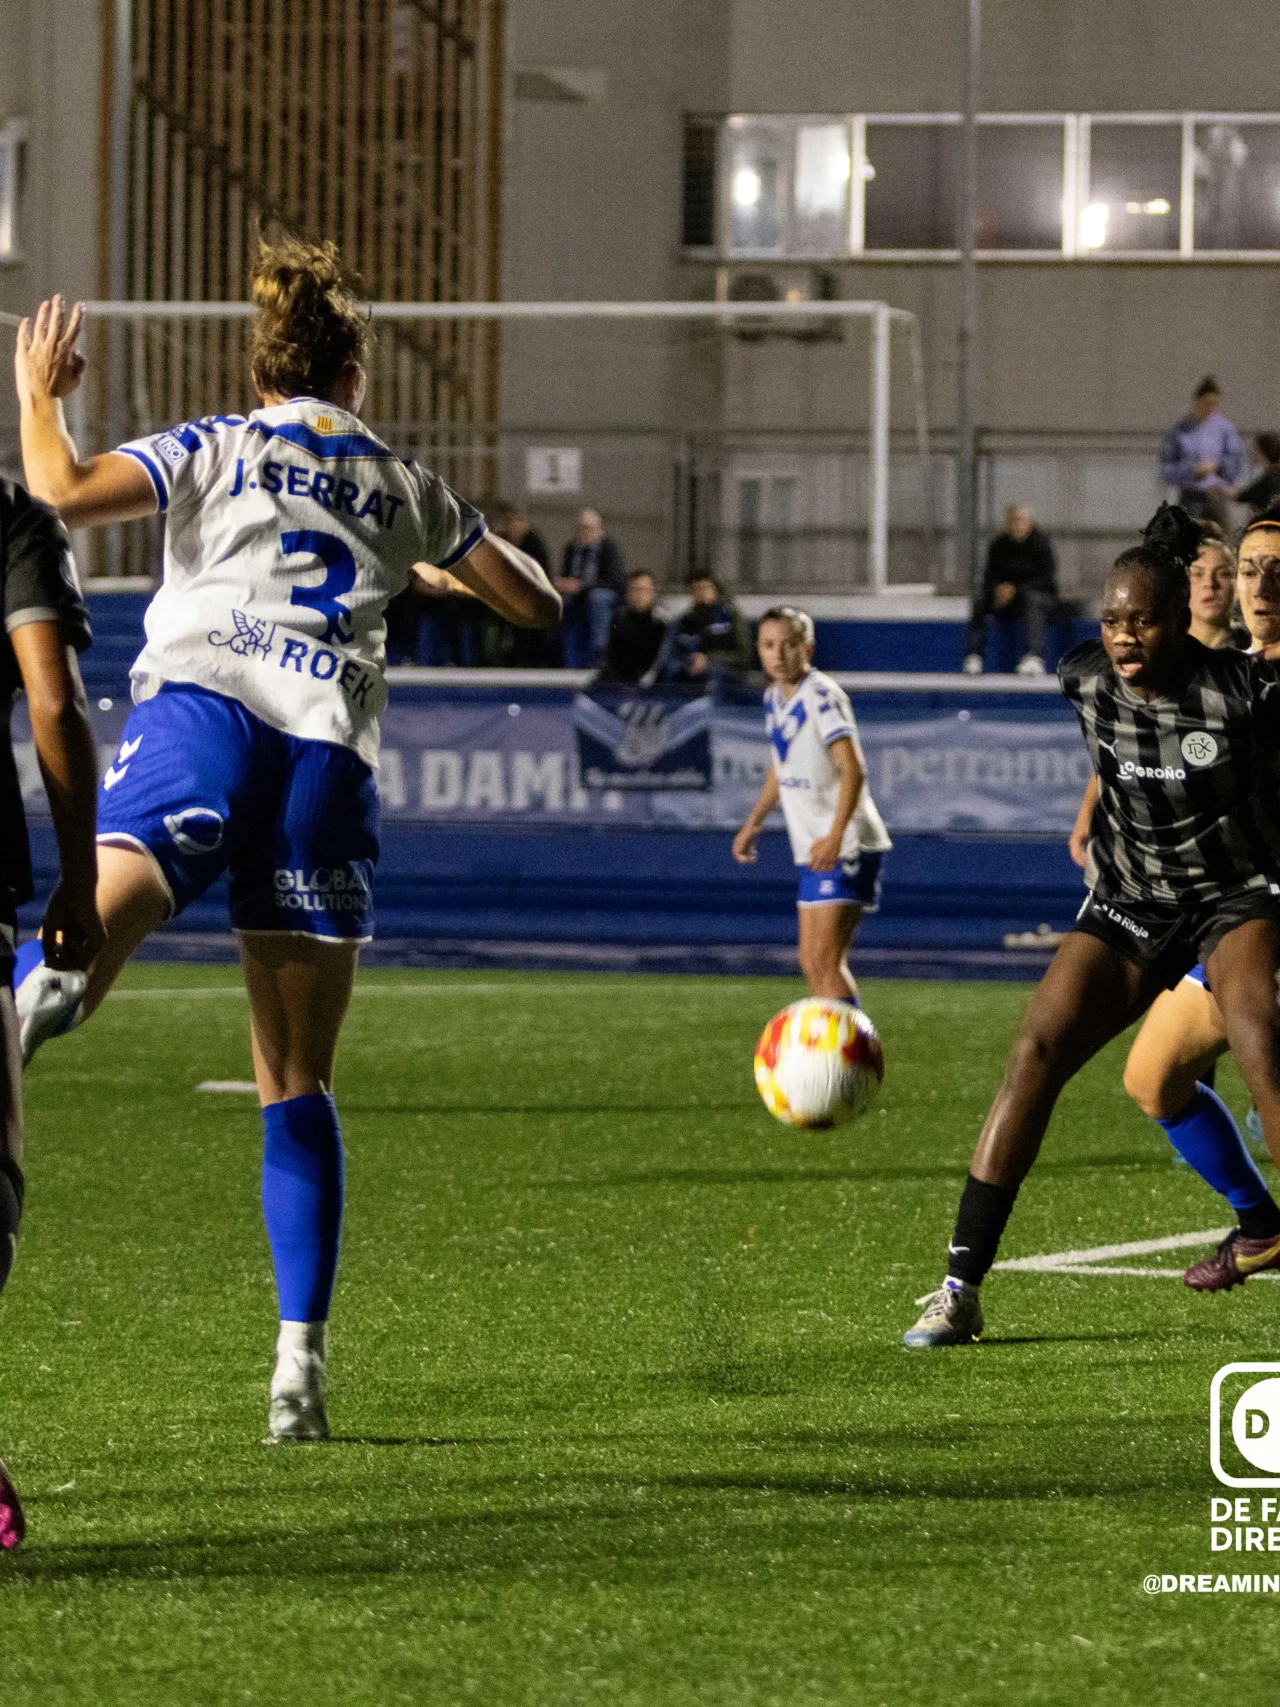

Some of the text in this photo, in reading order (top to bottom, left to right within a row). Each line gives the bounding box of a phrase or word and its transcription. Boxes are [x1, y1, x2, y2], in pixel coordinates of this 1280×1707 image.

[229, 458, 404, 529] J.SERRAT
[281, 530, 357, 646] 3
[1117, 761, 1186, 780] LOGROÑO
[273, 868, 368, 892] GLOBA
[1108, 908, 1149, 938] La Rioja
